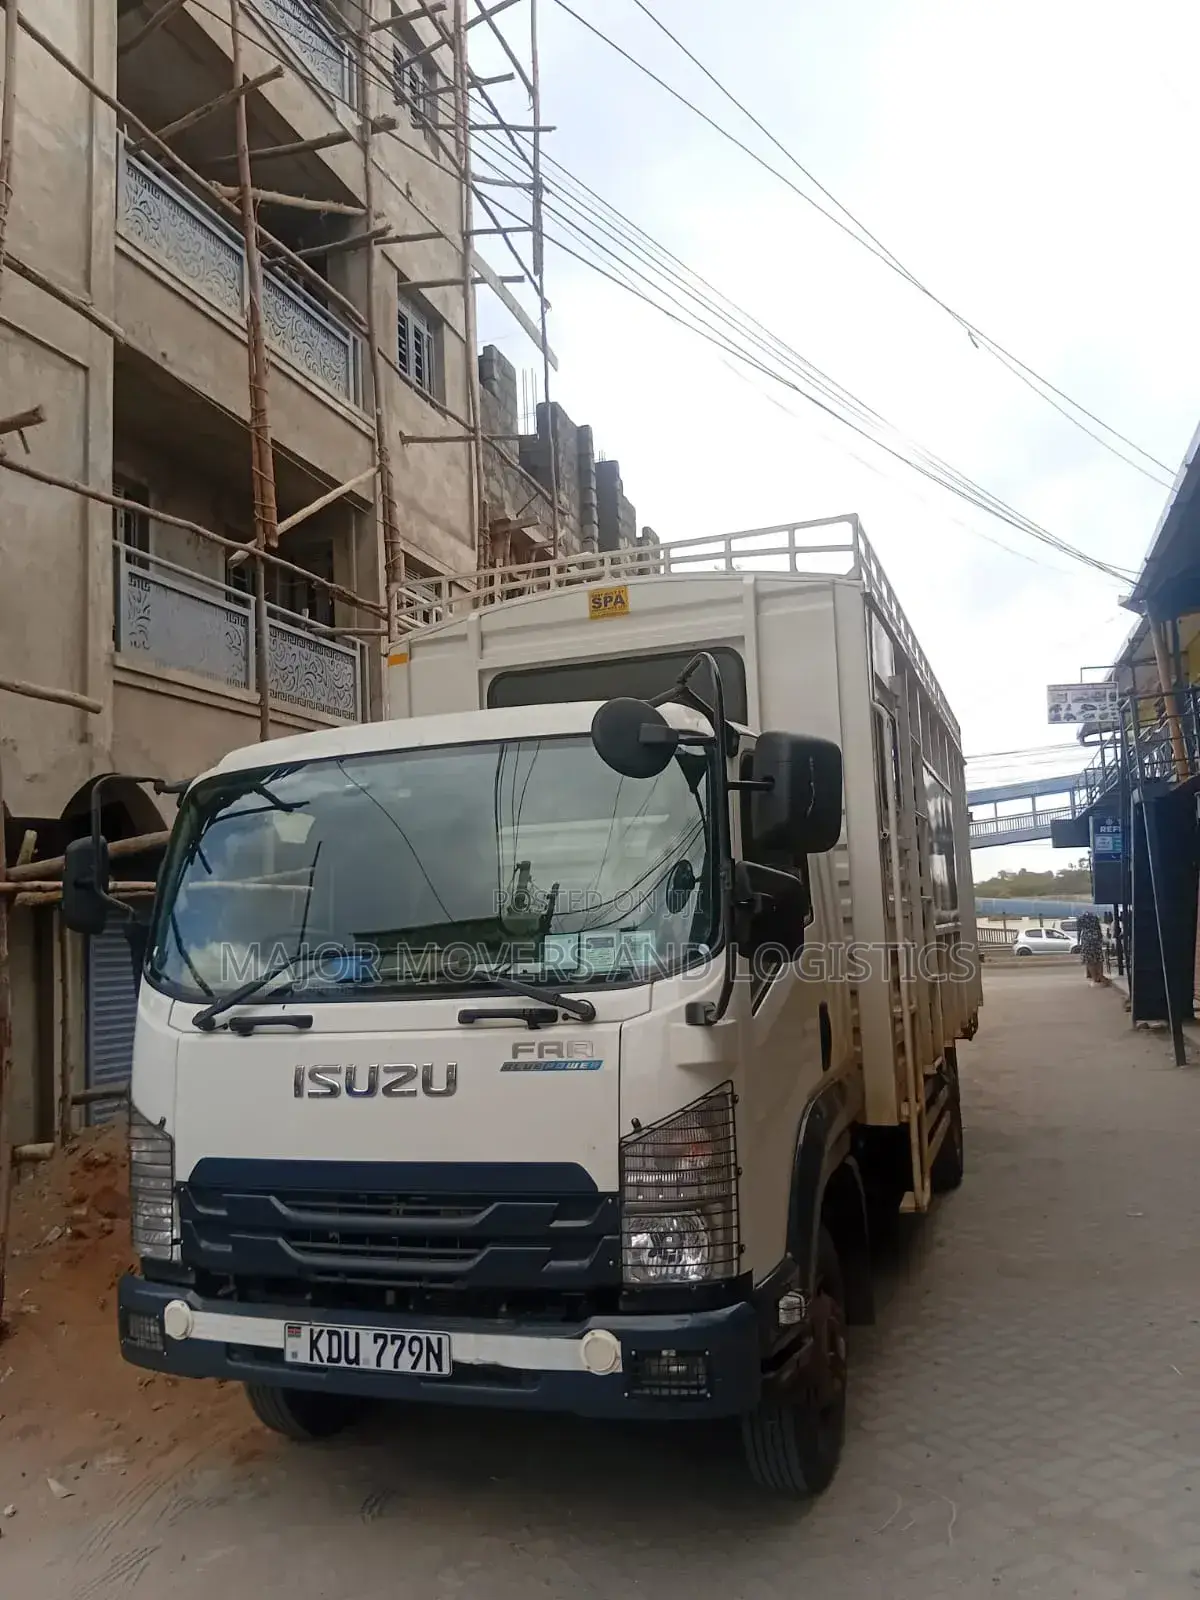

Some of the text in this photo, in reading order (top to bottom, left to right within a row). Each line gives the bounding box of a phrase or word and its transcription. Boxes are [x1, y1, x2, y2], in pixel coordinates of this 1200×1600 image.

[591, 594, 625, 609] SPA
[293, 1062, 458, 1099] ISUZU
[309, 1327, 443, 1373] KDU 779N
